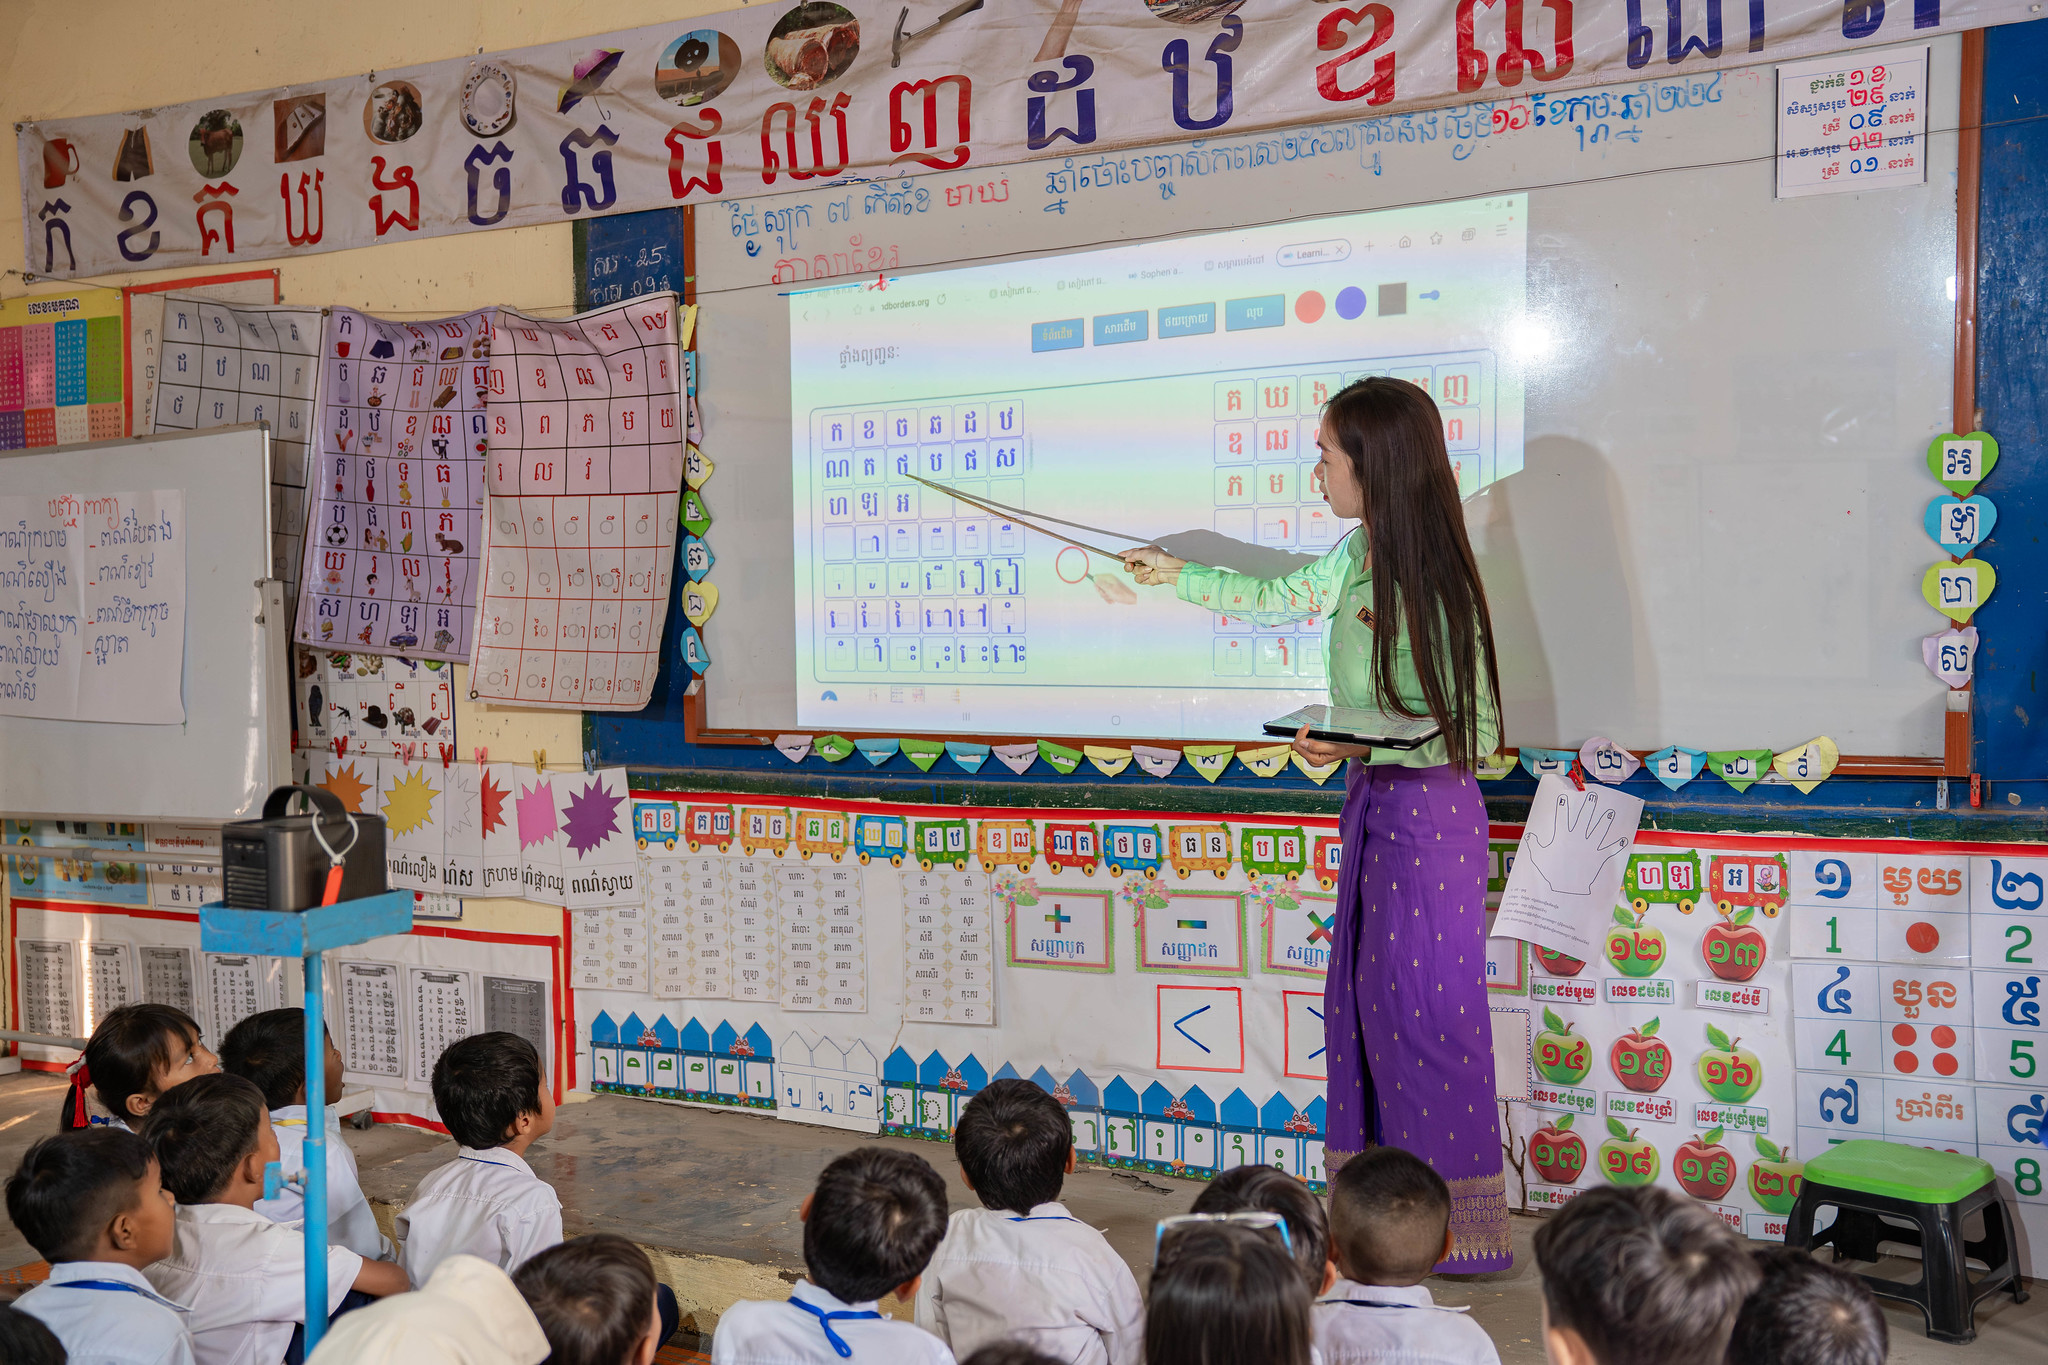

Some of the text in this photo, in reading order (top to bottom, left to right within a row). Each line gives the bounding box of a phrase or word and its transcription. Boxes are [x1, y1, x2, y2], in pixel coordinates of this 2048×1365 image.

[1810, 73, 1845, 94] ថ្នាក់ទី
[1847, 84, 1884, 107] ២៩
[1890, 86, 1915, 102] នាក់
[1823, 105, 1914, 136] ស្រី ០៩ នាក់
[38, 198, 76, 273] ក
[117, 191, 160, 262] ខ
[193, 181, 239, 256] គ
[281, 168, 324, 247] ឃ
[369, 156, 419, 236] ង
[464, 141, 514, 226] ច
[560, 124, 620, 214] ឆ
[664, 108, 723, 199] ជ
[761, 92, 856, 188] ឈ
[886, 75, 972, 170] ញ
[1027, 55, 1096, 150] ដ
[1158, 11, 1243, 130] ឋ
[1316, 3, 1395, 107] ឌ
[1849, 131, 1883, 152] ០២
[1822, 162, 1840, 180] ស្រី
[1888, 153, 1913, 169] នាក់
[1228, 390, 1241, 411] គ
[832, 407, 1013, 441] ក ខ ច ឆ ដ ឋ
[997, 448, 1015, 467] ស
[1947, 449, 1971, 474] អ
[1228, 476, 1242, 496] ភ
[829, 493, 909, 516] ហ ឡ អ
[319, 598, 449, 632] ស ហ ឡ អ
[644, 811, 671, 829] ក ខ
[929, 830, 960, 847] ដ ឋ
[993, 833, 1028, 848] ឌ ឍ
[1118, 837, 1151, 853] ថ ទ
[1257, 840, 1293, 857] ប ផ
[483, 866, 518, 888] ក្រហម
[572, 869, 633, 896] ពណ៌ស្វាយ
[1640, 862, 1693, 890] ហ ឡ
[1729, 869, 1743, 886] អ
[1815, 859, 2043, 910] ១ មួយ ២
[1031, 937, 1085, 960] សញ្ញាបូក
[1161, 942, 1218, 962] សញ្ញាដក
[1610, 931, 1759, 967] ១២ ១៣
[1826, 917, 2032, 963] 1 2
[1532, 980, 1595, 1003] លេខដប់មួយ
[1612, 981, 1671, 999] លេខដប់ពីរ
[1818, 966, 2040, 1026] ៤ បួន ៥
[1542, 1040, 1754, 1087] ១៤ ១៥ ១៦
[1825, 1030, 2036, 1078] 4 5
[1820, 1079, 1858, 1124] ៧
[1896, 1092, 1963, 1122] ប្រាំពីរ
[1536, 1140, 1728, 1186] ១៧ ១៨ ១៩
[2015, 1158, 2042, 1196] 8
